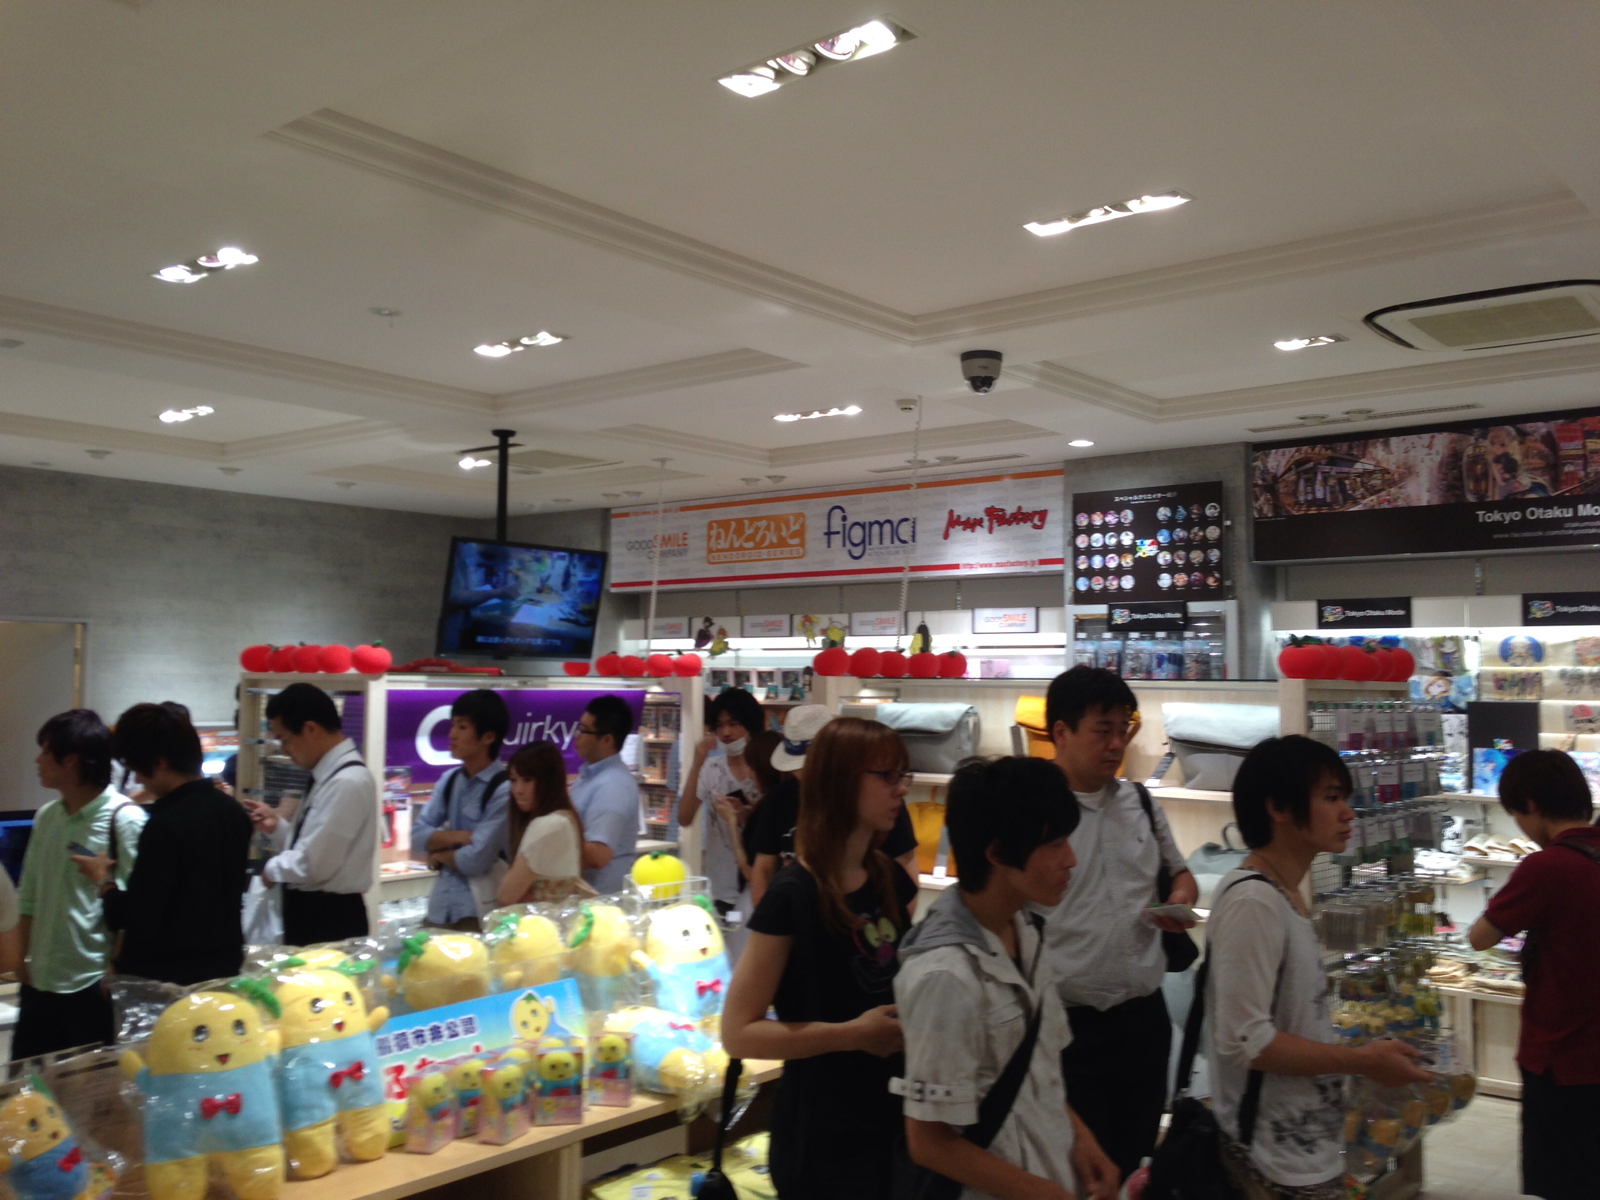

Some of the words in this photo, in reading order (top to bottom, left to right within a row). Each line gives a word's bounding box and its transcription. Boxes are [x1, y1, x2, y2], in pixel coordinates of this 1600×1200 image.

[983, 505, 1048, 535] Factory
[1475, 510, 1522, 524] Tokyo
[1525, 506, 1573, 520] Otaku
[709, 515, 804, 552] ねんどろいど
[823, 505, 916, 560] figma
[647, 547, 689, 560] CMPANY
[766, 547, 801, 559] SERIES
